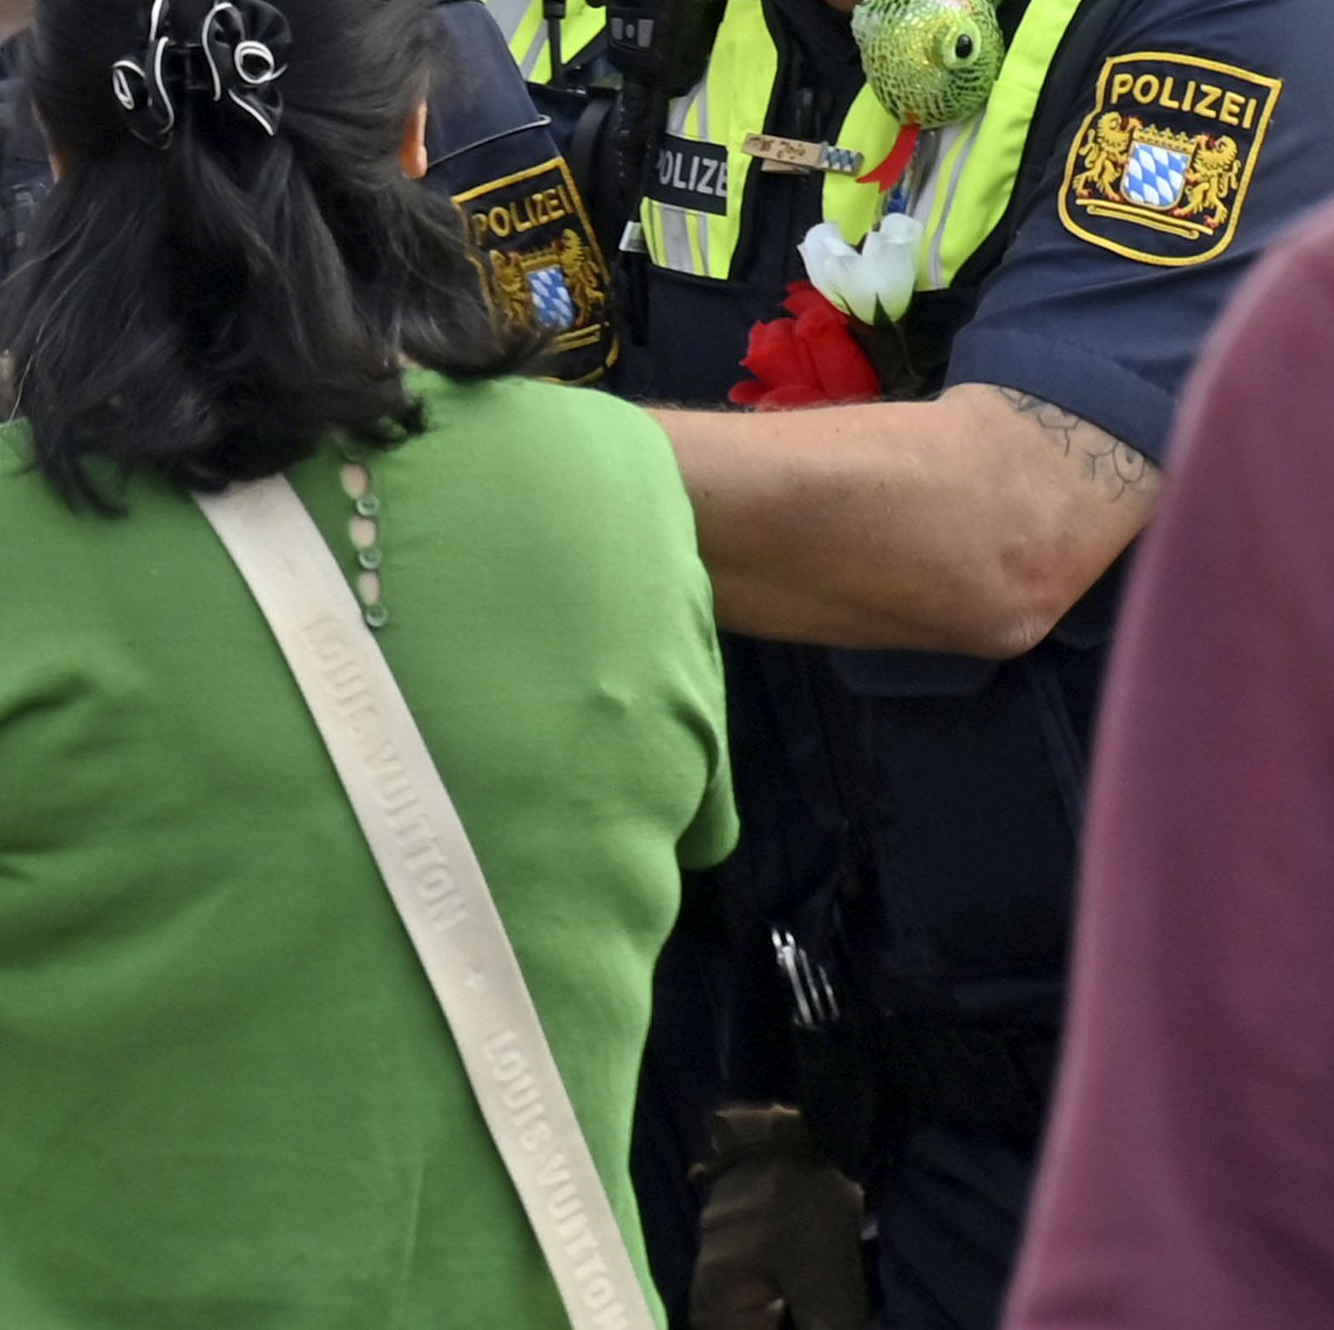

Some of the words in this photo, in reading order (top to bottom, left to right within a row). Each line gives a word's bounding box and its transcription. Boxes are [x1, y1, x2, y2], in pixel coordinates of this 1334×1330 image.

[1110, 73, 1257, 129] POLIZEI
[472, 184, 573, 246] POLIZEI
[364, 738, 469, 932] VUITTON
[483, 1028, 552, 1151] LOUIS
